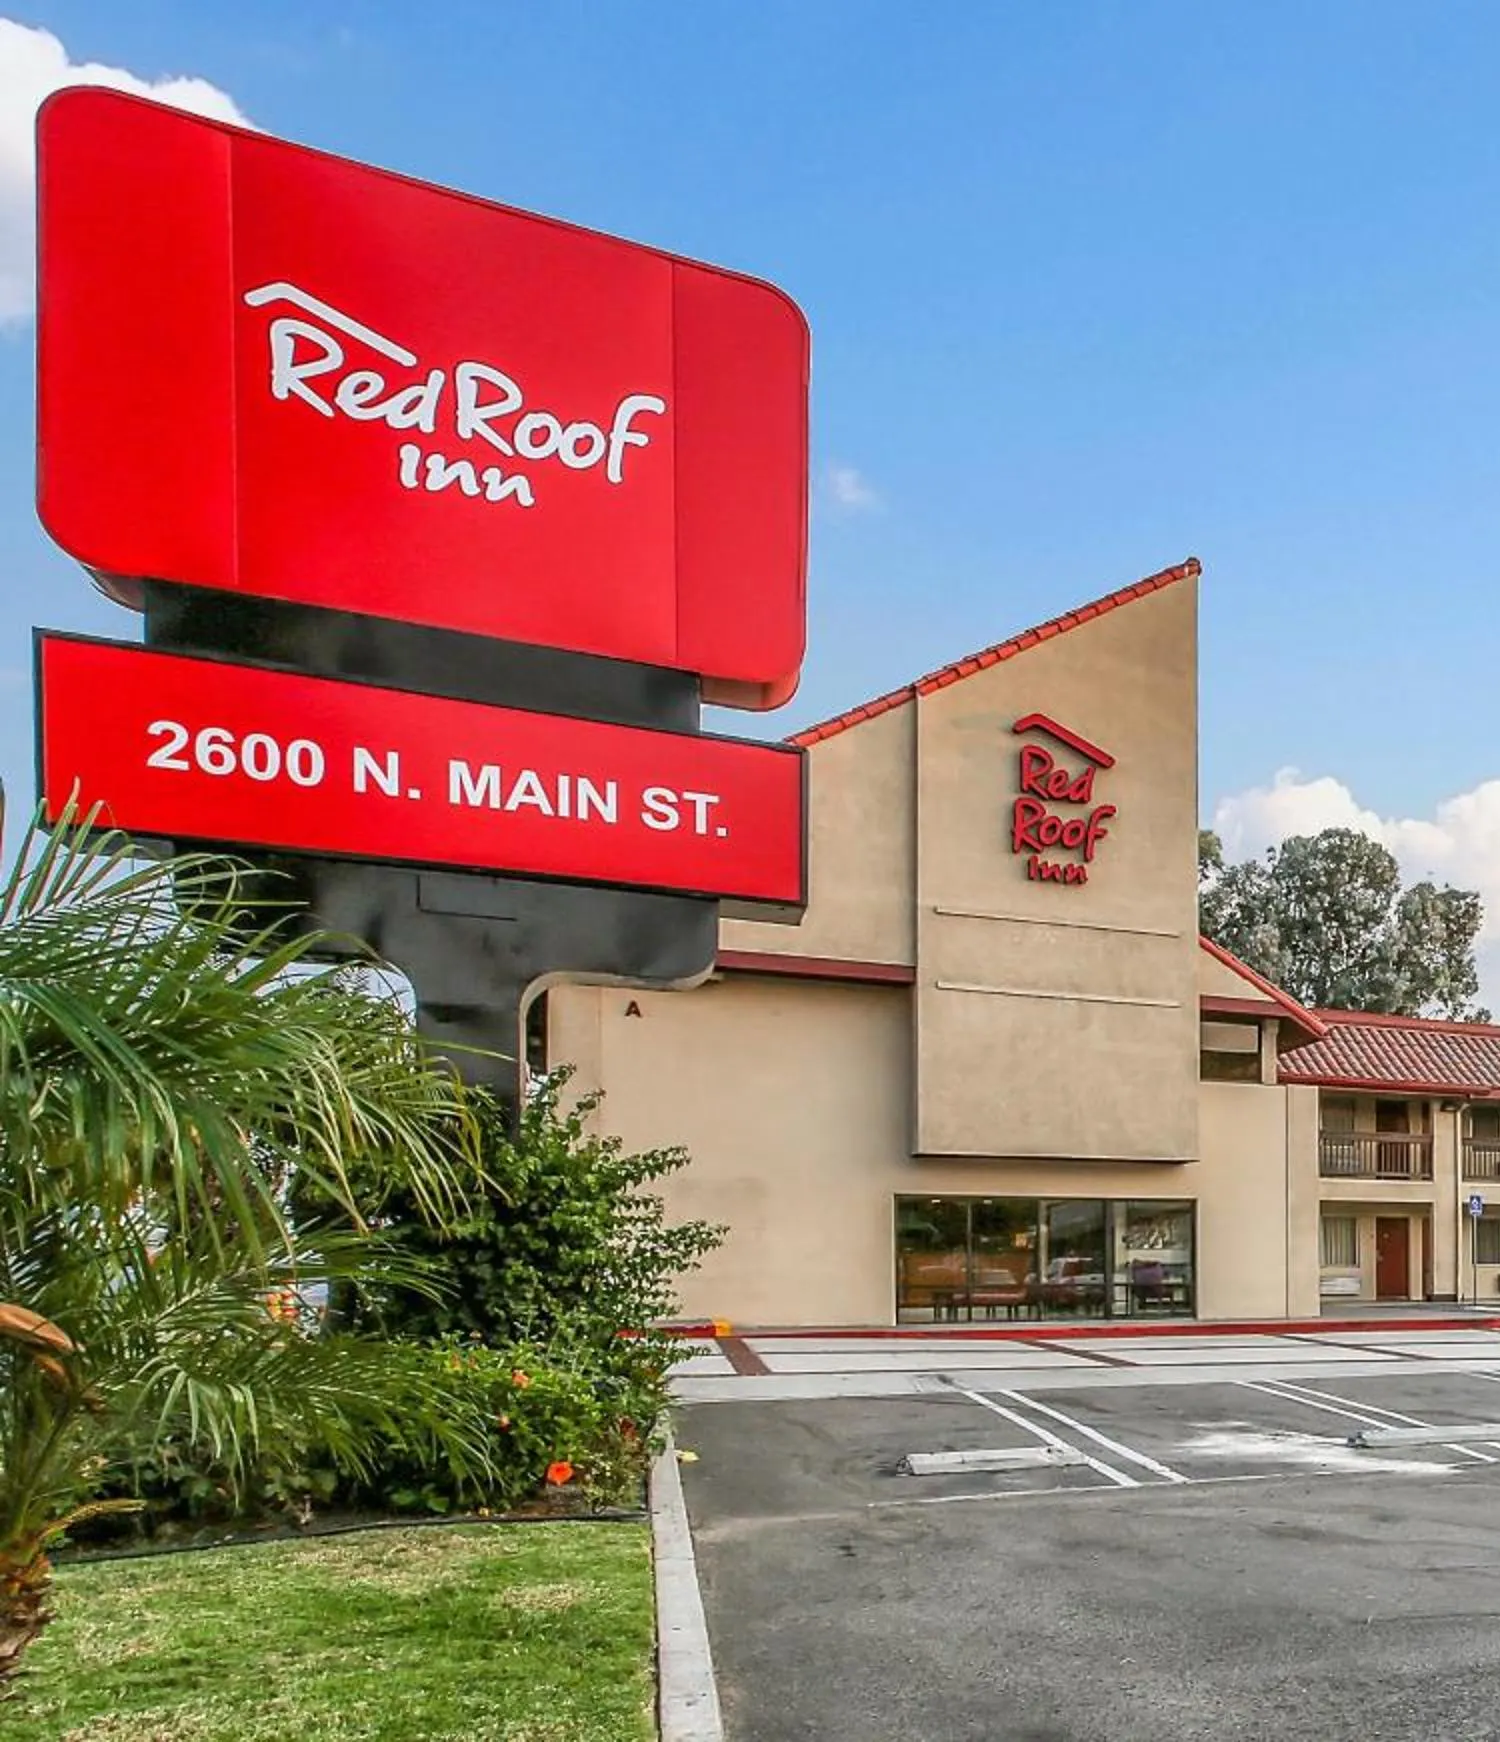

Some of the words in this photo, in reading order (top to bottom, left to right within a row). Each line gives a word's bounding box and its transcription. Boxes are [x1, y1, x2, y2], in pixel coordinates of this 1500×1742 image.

[268, 317, 447, 435] Red
[454, 361, 667, 485] Roof
[147, 720, 326, 786] 2600
[353, 747, 422, 799] N.
[449, 759, 619, 825] MAIN
[641, 787, 728, 838] ST.
[1020, 744, 1096, 804] Red
[1012, 797, 1117, 862] Roof
[623, 999, 643, 1018] A
